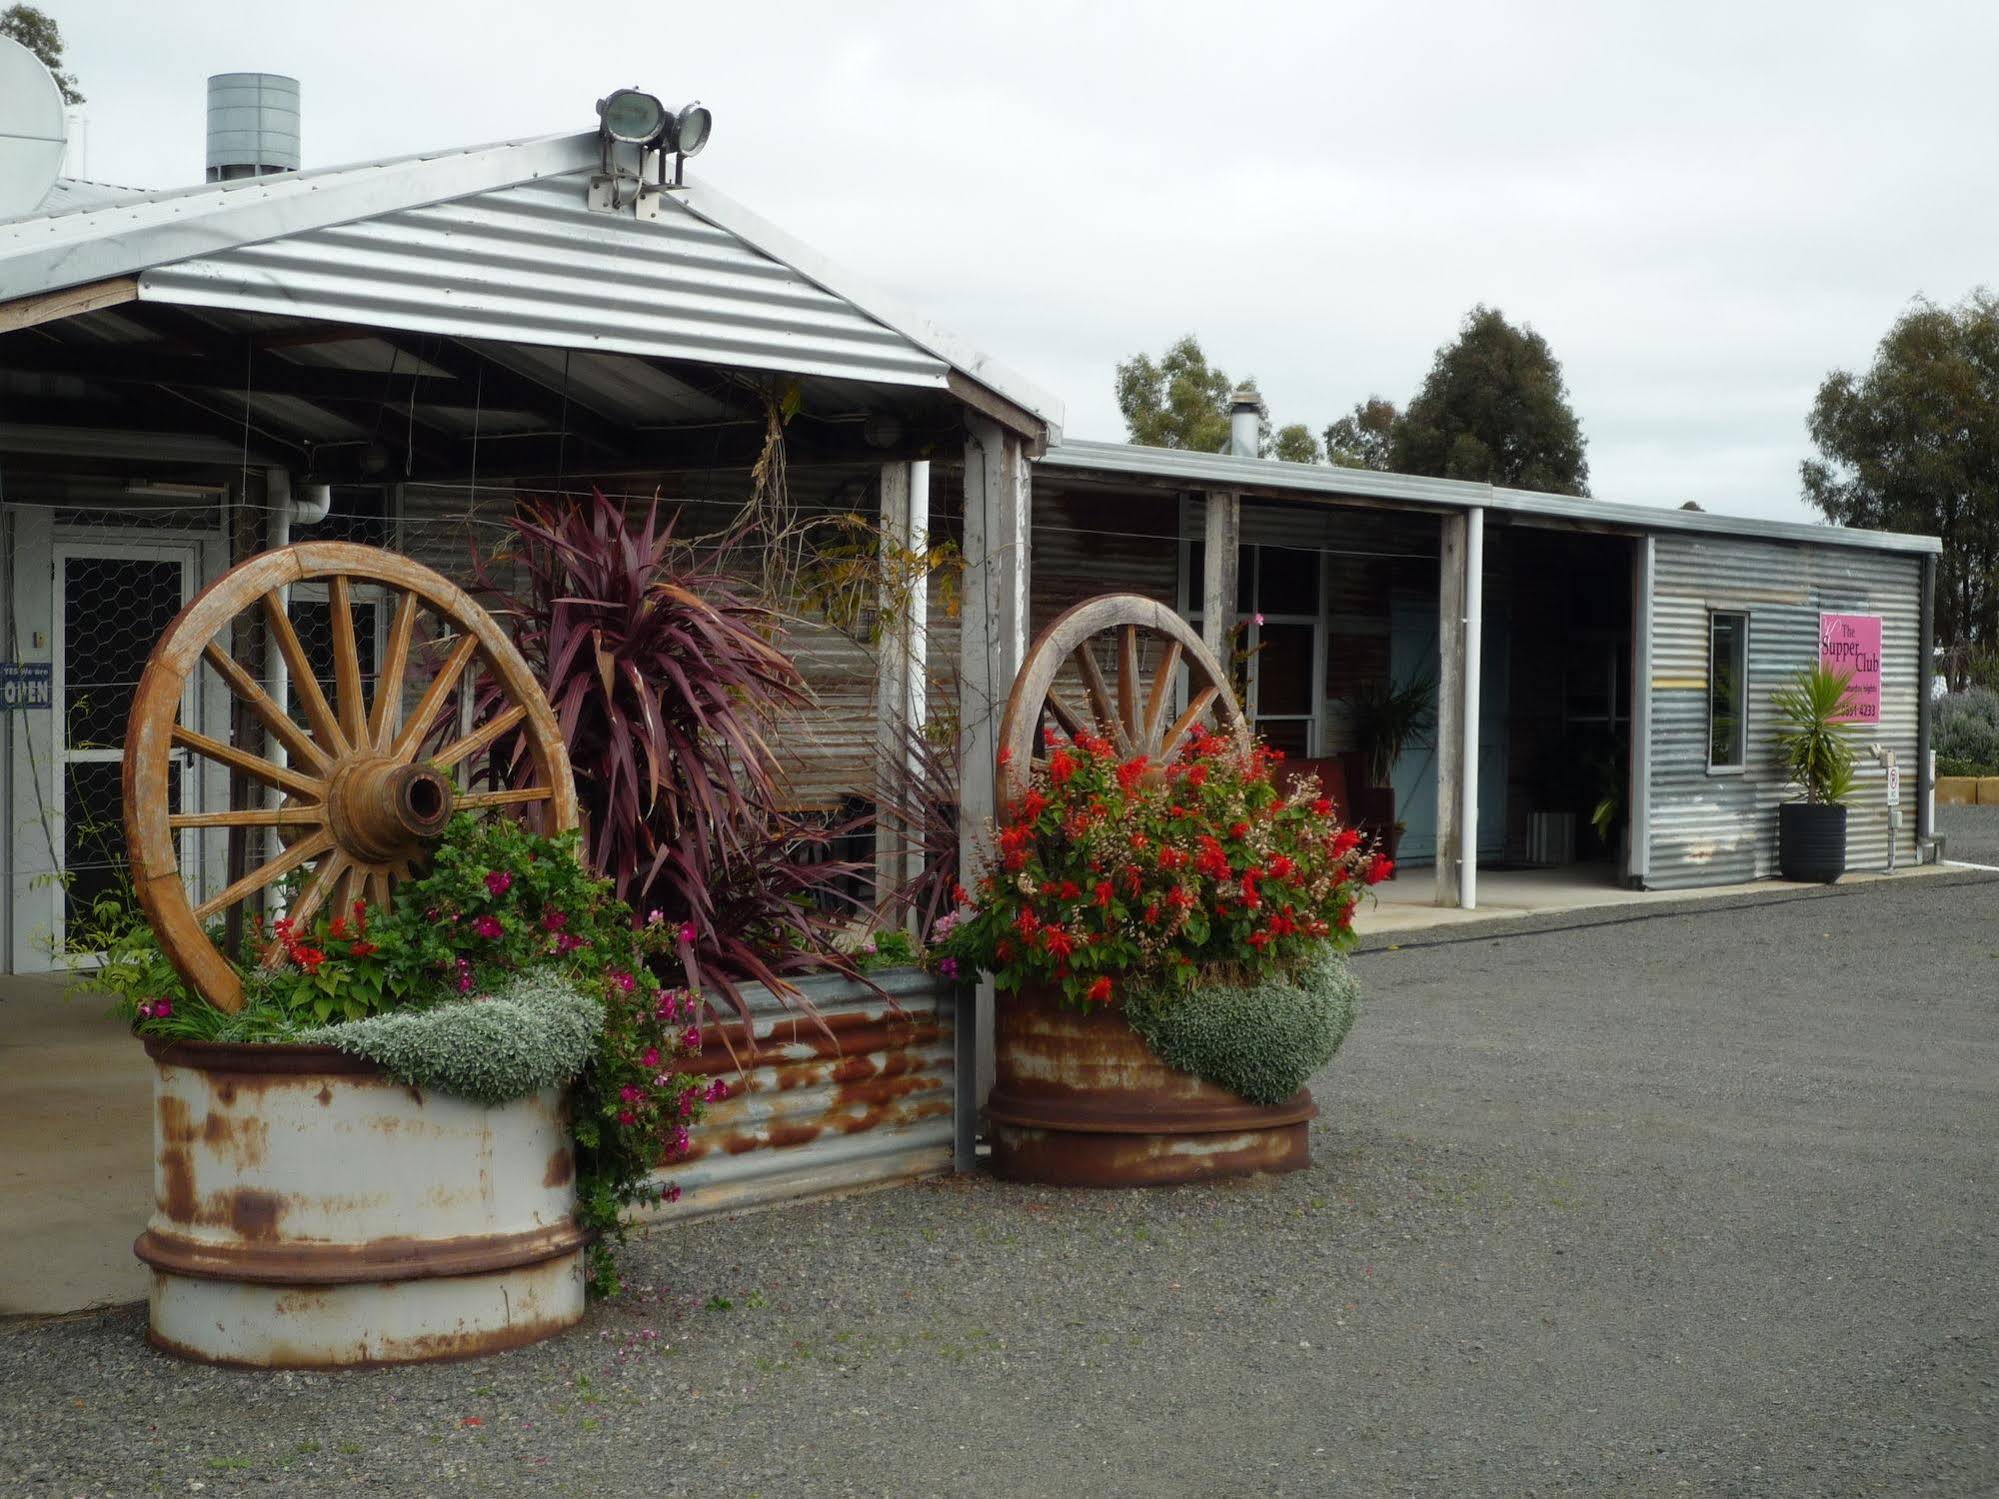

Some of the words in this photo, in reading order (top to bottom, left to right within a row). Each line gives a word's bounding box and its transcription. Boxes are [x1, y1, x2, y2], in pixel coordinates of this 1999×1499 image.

[1842, 624, 1855, 638] The
[1822, 635, 1859, 662] Supper
[1855, 652, 1879, 673] Club
[4, 680, 48, 704] OPEN
[1859, 704, 1876, 717] 4233
